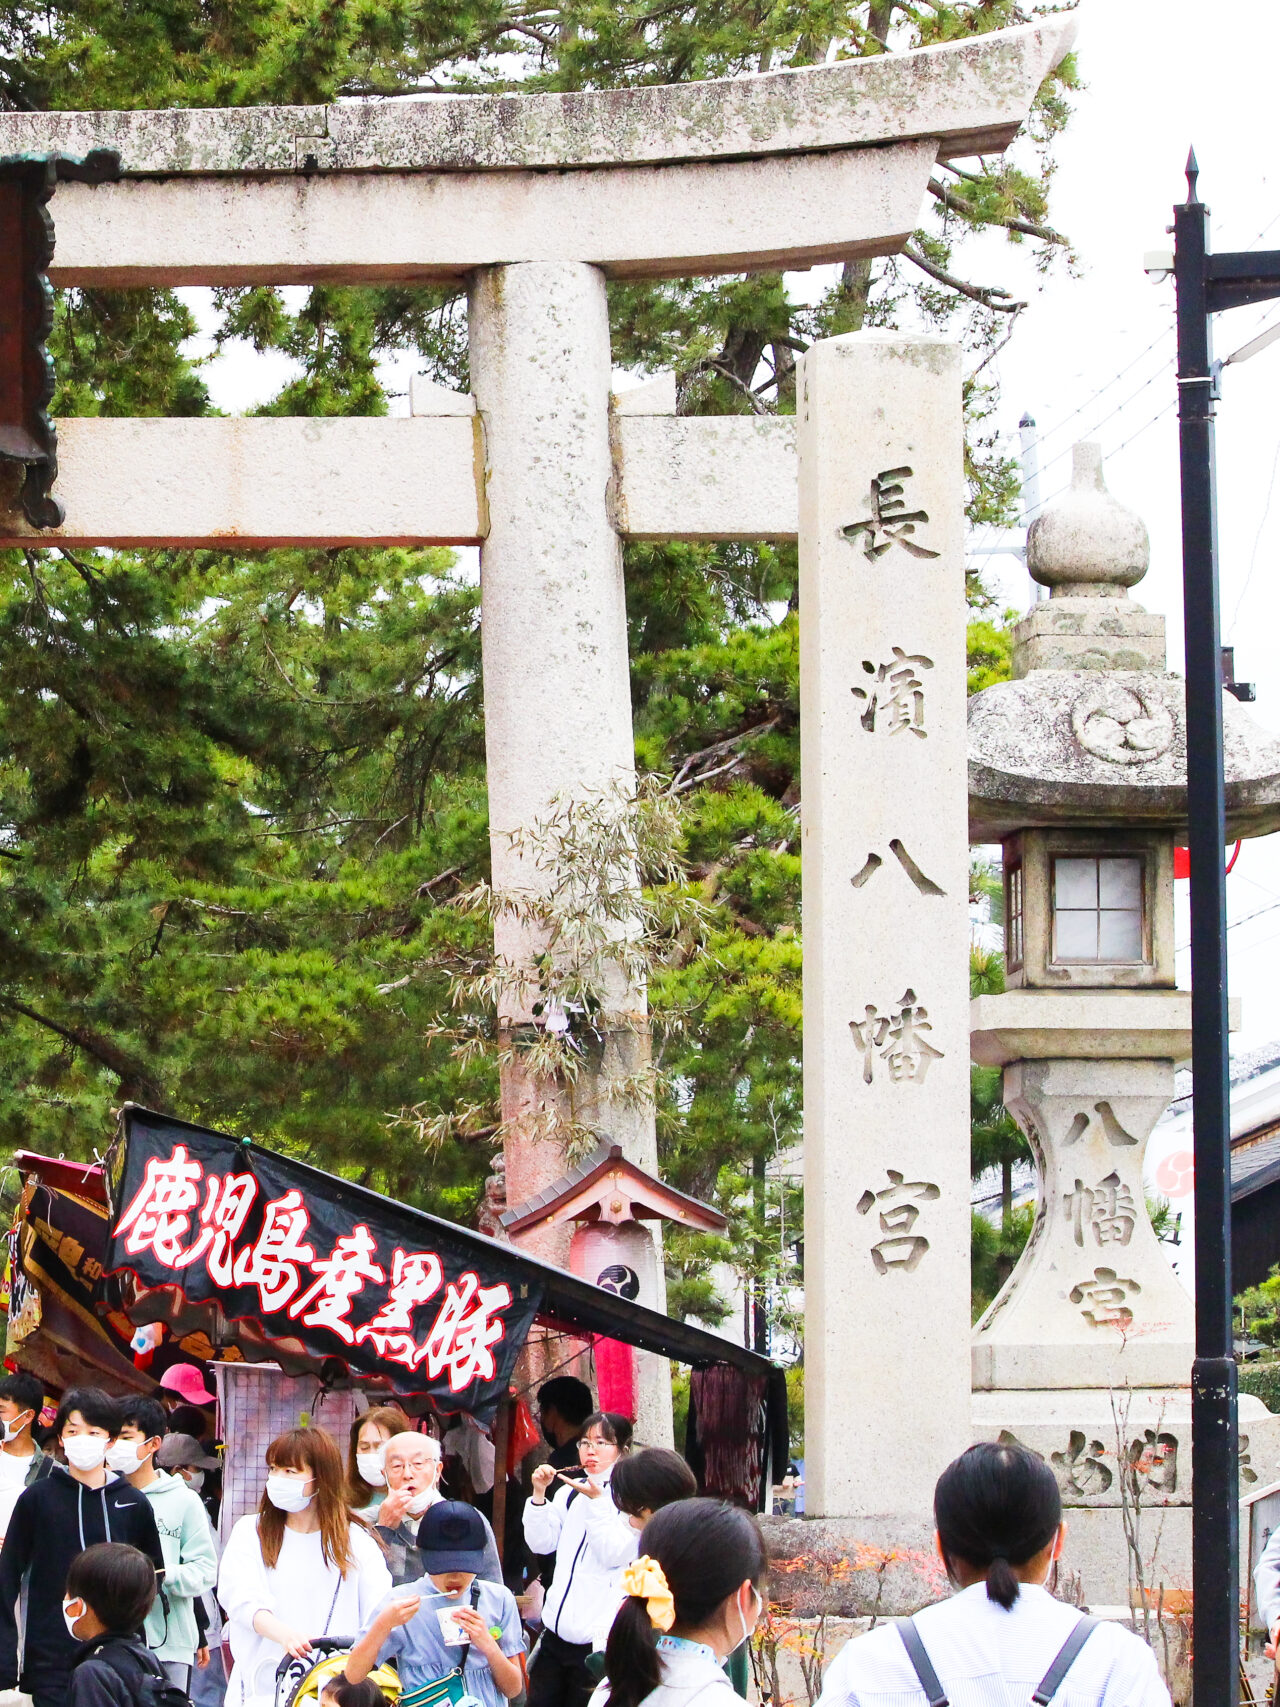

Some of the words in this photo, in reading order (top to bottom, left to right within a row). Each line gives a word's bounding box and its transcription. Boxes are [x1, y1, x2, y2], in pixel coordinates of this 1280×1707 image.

[110, 1143, 513, 1392] 鹿児島産黒豚
[1059, 1101, 1142, 1329] 八幡宮
